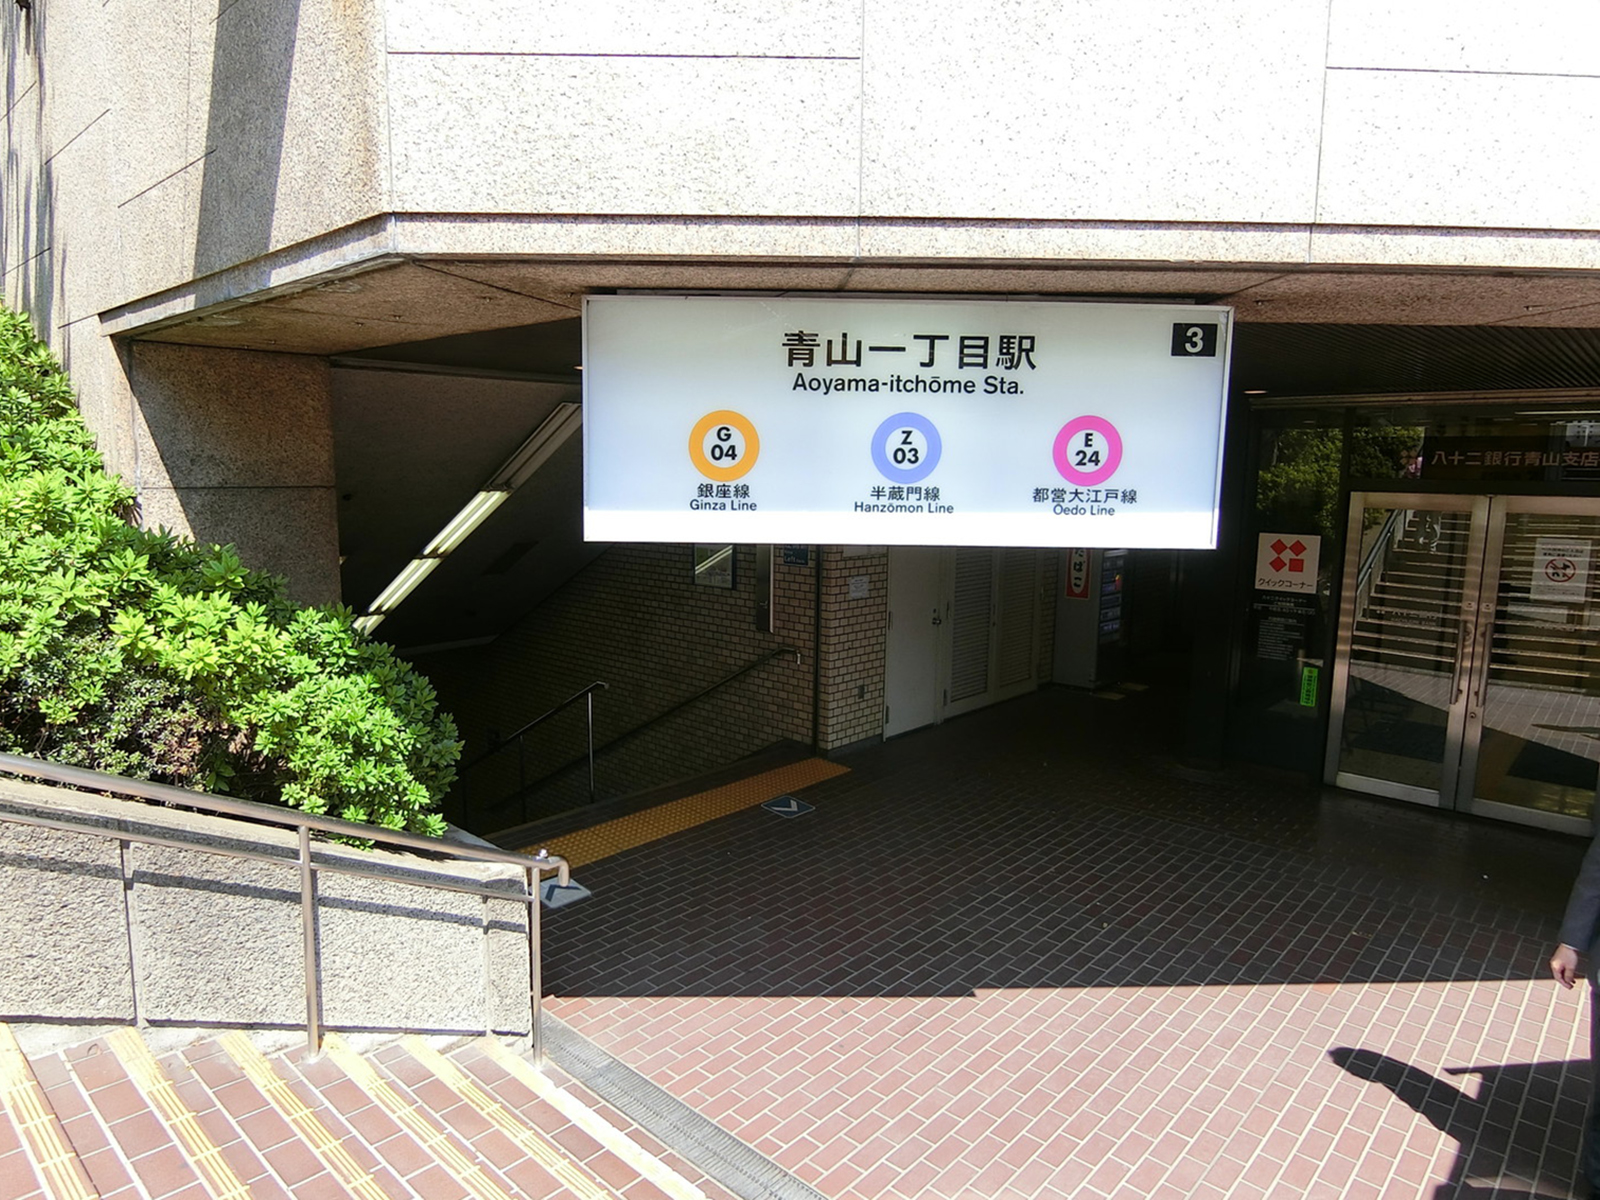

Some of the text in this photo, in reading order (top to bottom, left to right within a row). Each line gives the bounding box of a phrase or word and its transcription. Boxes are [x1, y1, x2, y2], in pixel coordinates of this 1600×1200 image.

[1184, 326, 1204, 354] 3
[782, 330, 1037, 371] 青山一丁目駅
[792, 373, 1024, 400] Aoyama-itchōme Sta.
[716, 426, 732, 442] G
[901, 430, 913, 445] Z
[1084, 432, 1094, 448] E
[710, 444, 738, 461] 04
[892, 447, 920, 464] 03
[1074, 450, 1101, 467] 24
[1431, 449, 1600, 468] 八十二銀行青山支店
[696, 483, 751, 499] 銀座線
[870, 486, 941, 502] 半蔵門線
[1032, 487, 1138, 504] 都営大江戸線
[689, 499, 758, 511] Ginza Line
[854, 501, 955, 514] Hanzōmon Line
[1090, 504, 1116, 516] Line
[1257, 577, 1314, 589] クイックコーナー
